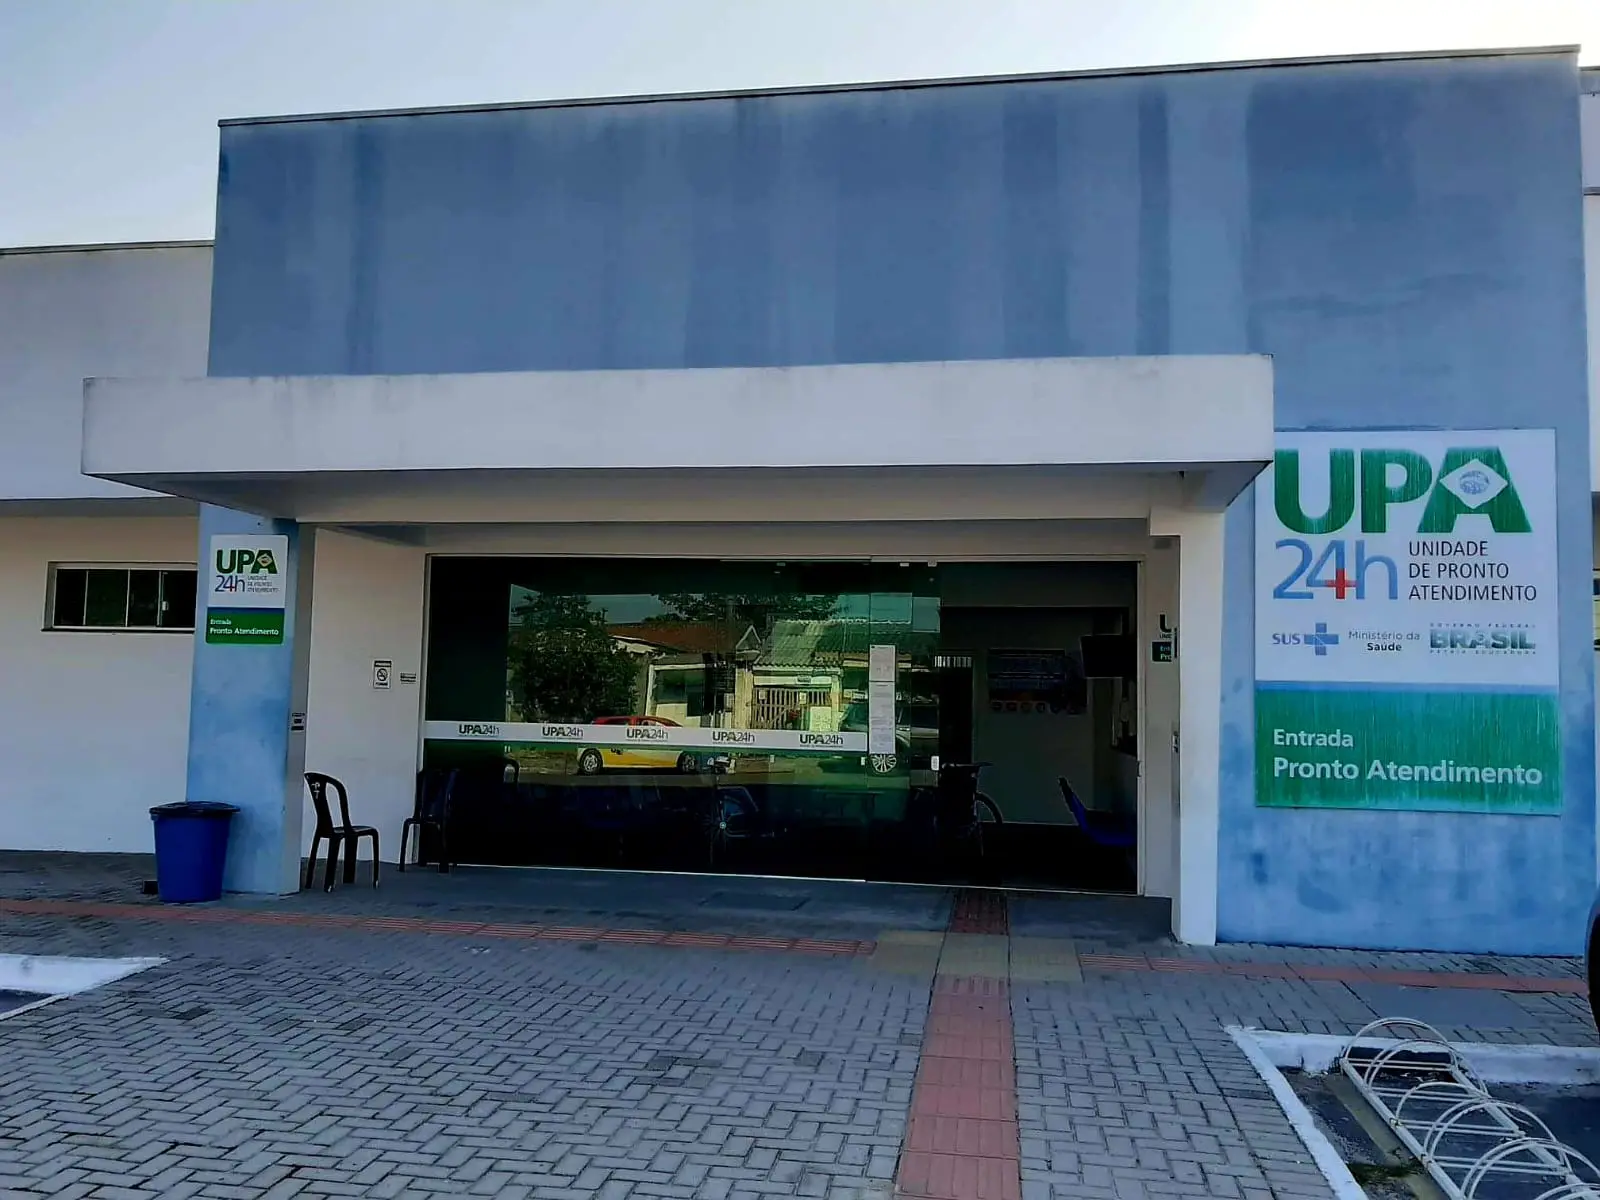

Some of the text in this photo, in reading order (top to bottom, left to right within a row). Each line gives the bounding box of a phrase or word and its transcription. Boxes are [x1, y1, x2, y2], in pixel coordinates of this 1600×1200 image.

[1274, 447, 1532, 534] UPA
[1408, 540, 1489, 556] UNIDADE
[216, 549, 277, 574] UPA
[1273, 538, 1398, 599] 24h
[1408, 563, 1509, 579] DE PRONTO
[215, 575, 246, 593] 24h
[1408, 585, 1537, 601] ATENDIMENTO
[234, 628, 279, 636] Atendimento
[1272, 633, 1300, 645] SUS
[1348, 631, 1420, 640] Ministério da
[1430, 629, 1536, 649] BRASIL
[1367, 642, 1402, 651] Saúde
[1273, 729, 1354, 747] Entrada
[1273, 757, 1543, 785] Pronto Atendimento
